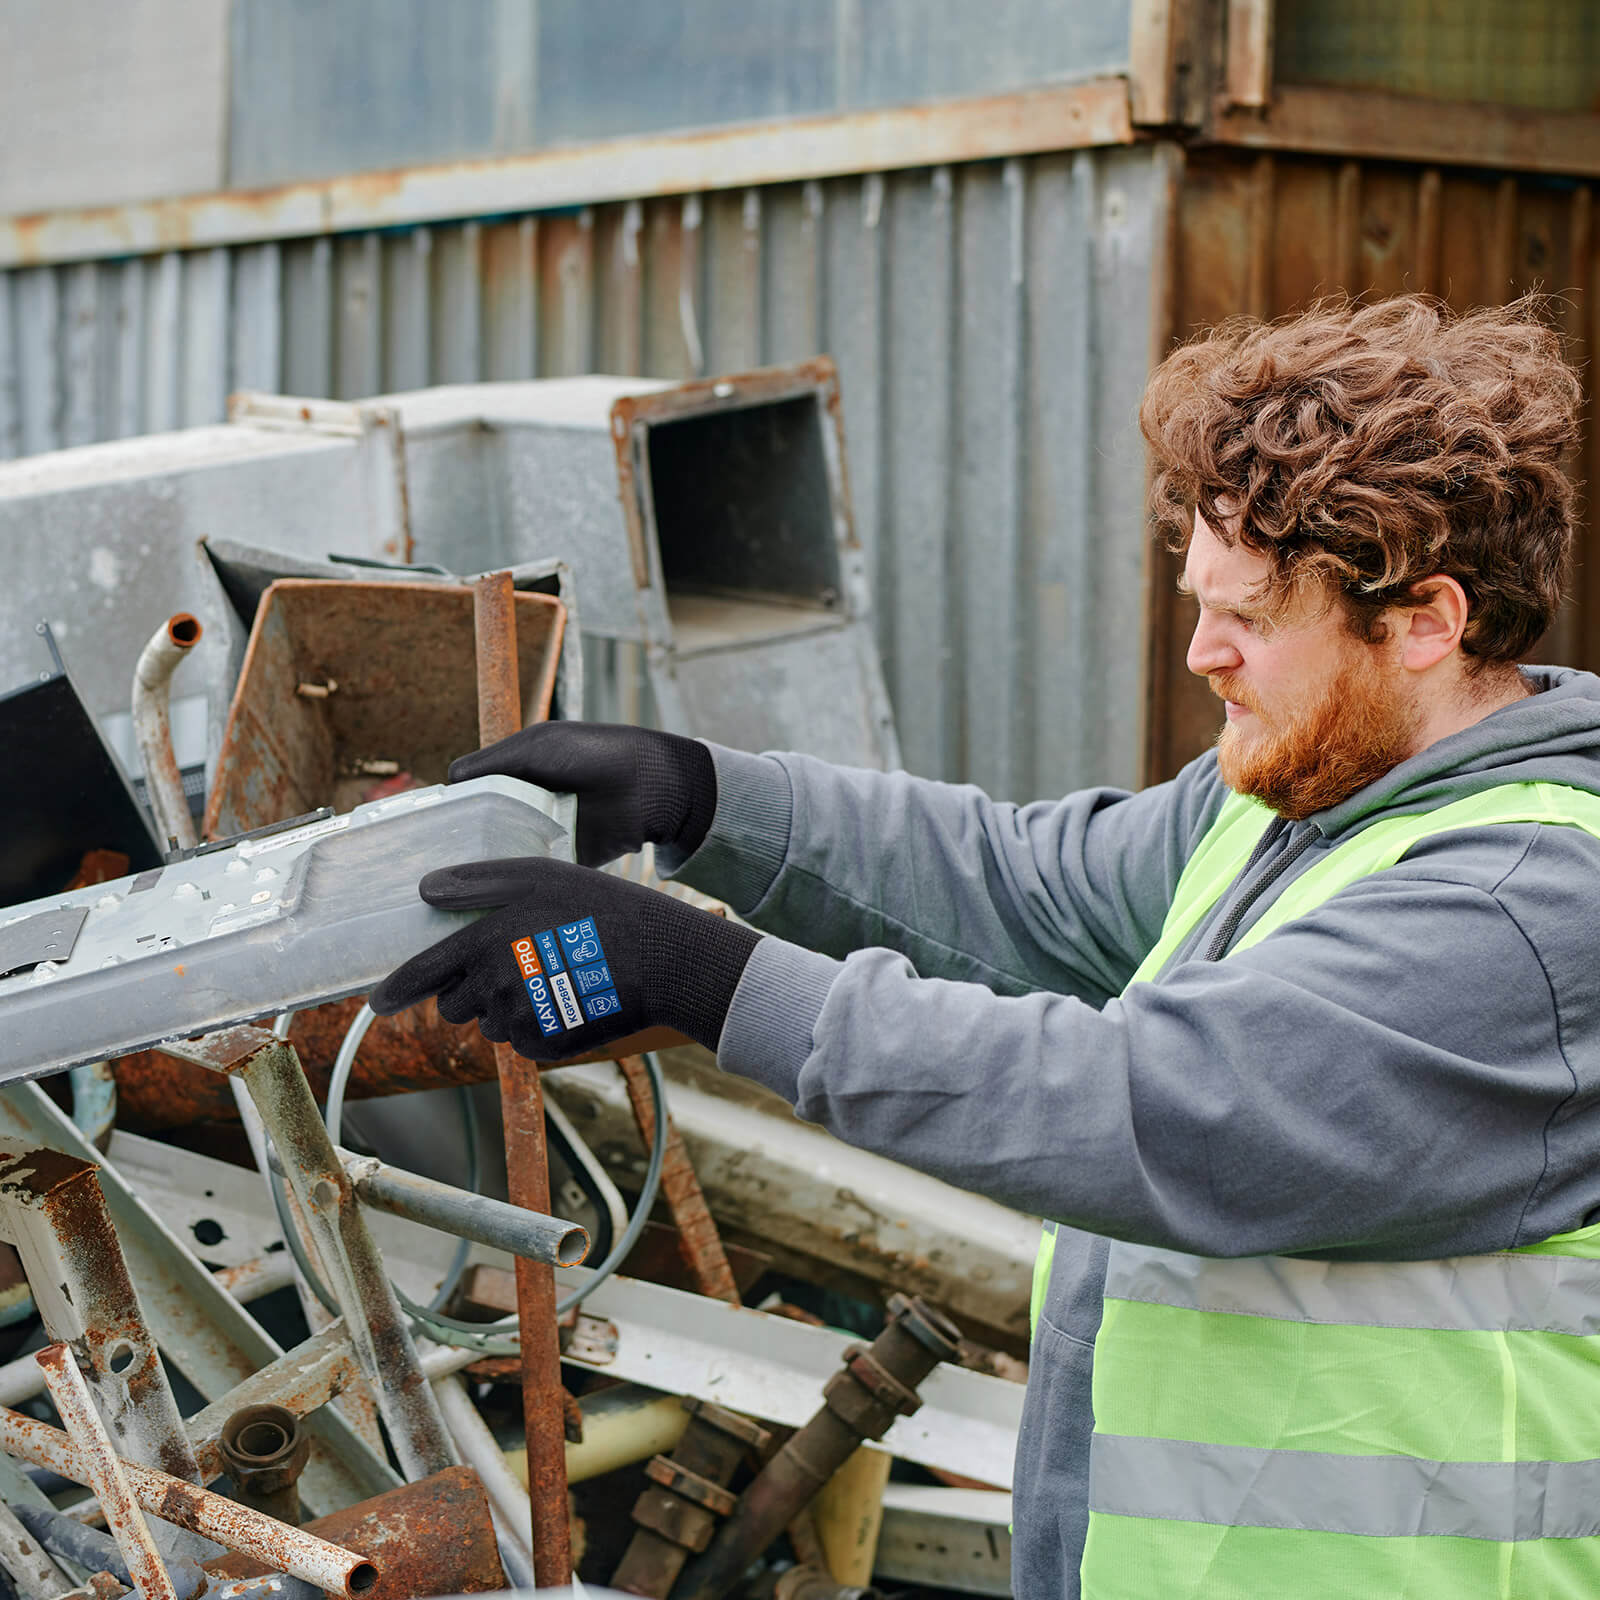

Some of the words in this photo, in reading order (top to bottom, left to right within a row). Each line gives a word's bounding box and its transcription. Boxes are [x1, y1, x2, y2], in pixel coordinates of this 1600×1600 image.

[563, 926, 579, 943] CE
[516, 941, 539, 975] PRO
[547, 949, 559, 970] SIZE:
[529, 977, 558, 1032] KAYGO
[597, 999, 606, 1010] A2
